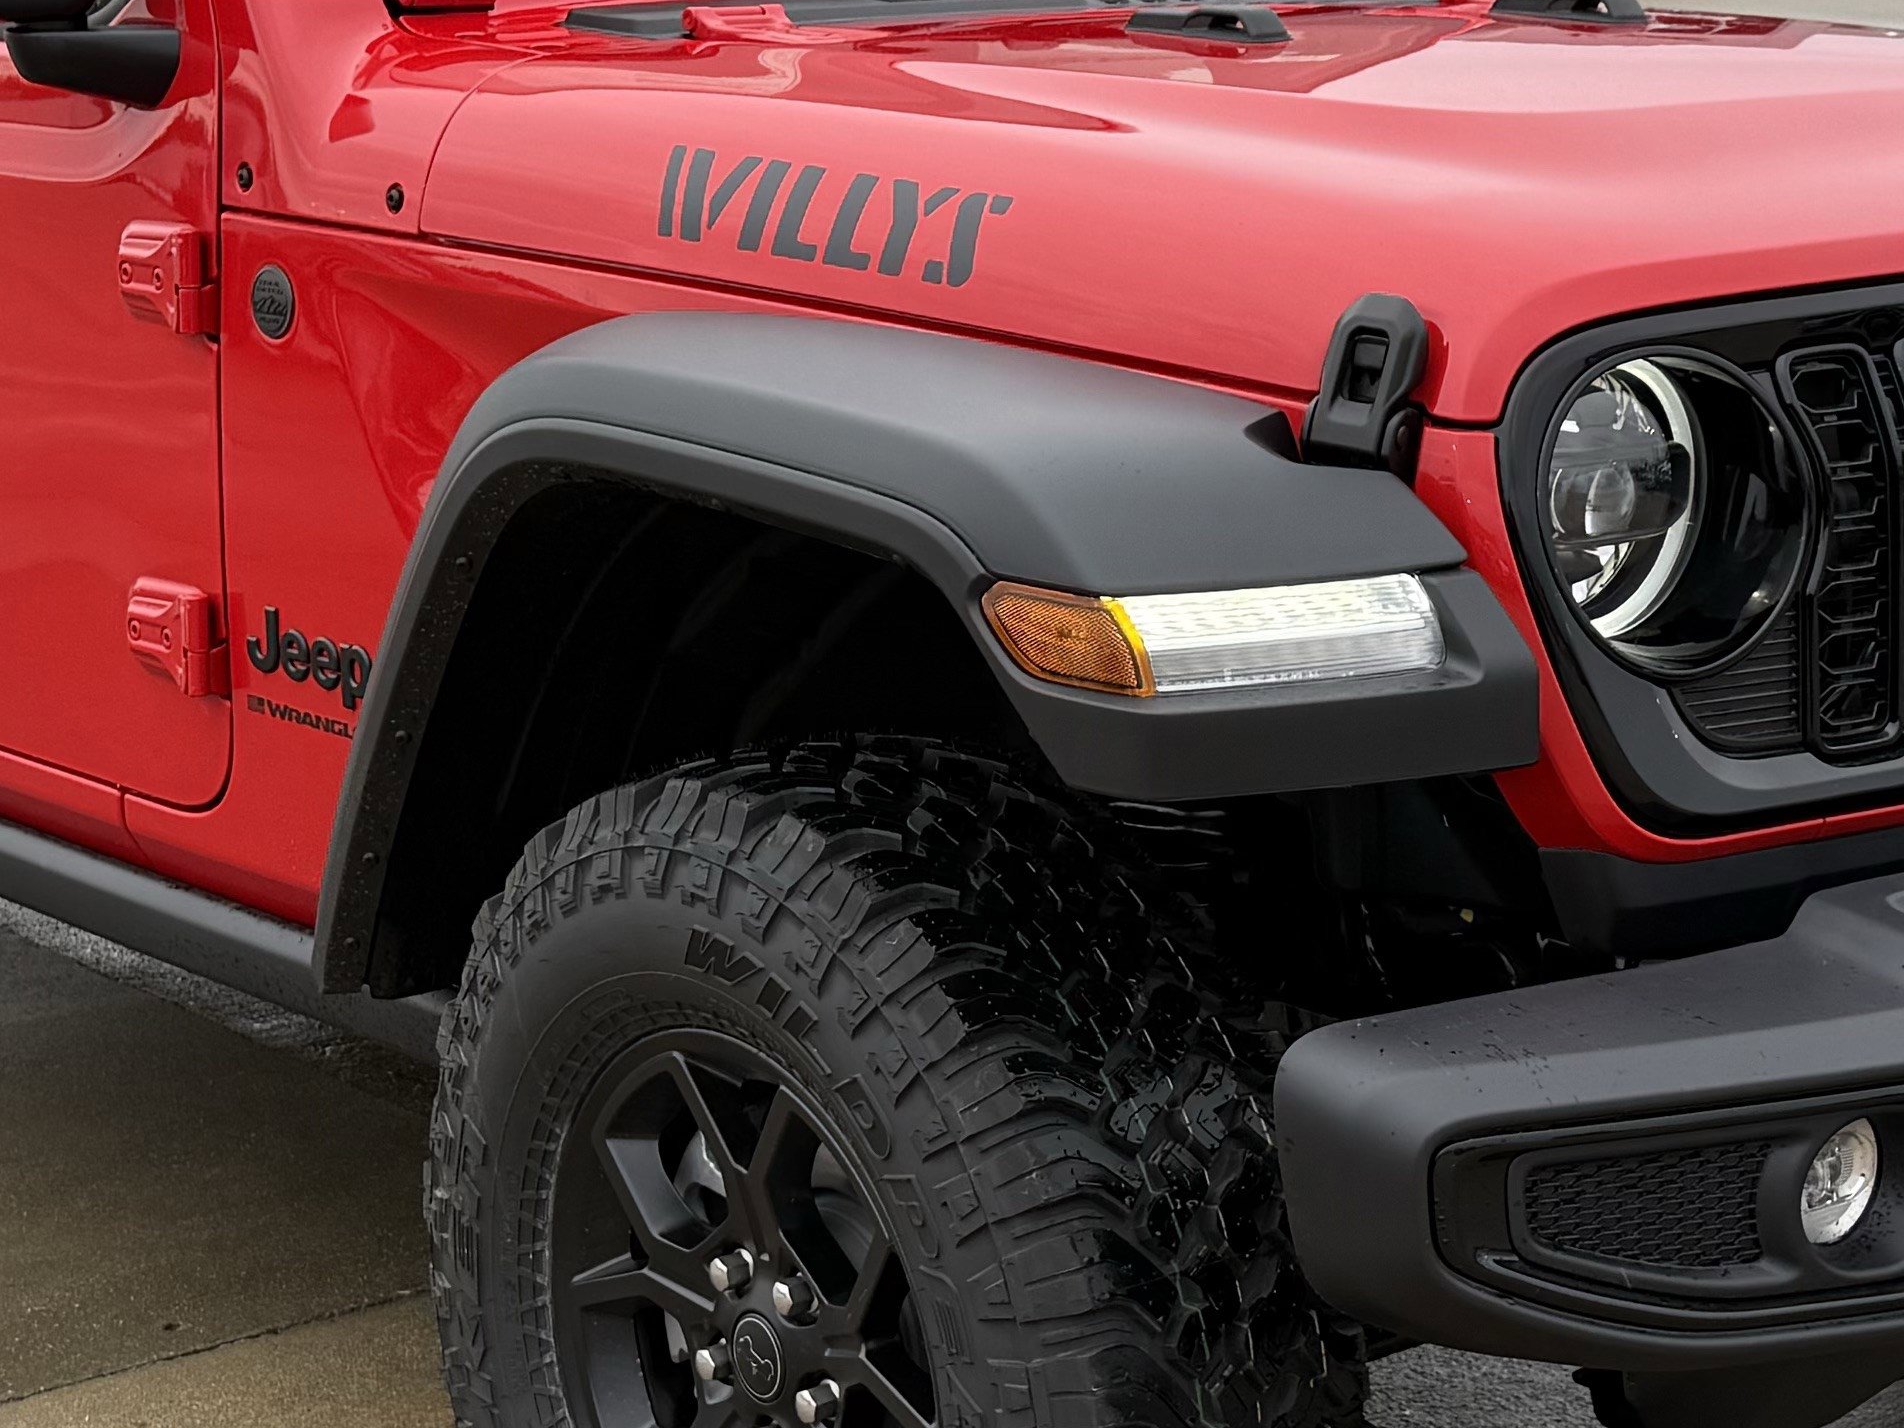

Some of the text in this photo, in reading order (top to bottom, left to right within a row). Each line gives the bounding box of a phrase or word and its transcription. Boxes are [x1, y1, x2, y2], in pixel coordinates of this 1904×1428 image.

[657, 144, 1014, 288] WILLYS
[246, 605, 373, 710] Jeep
[266, 699, 357, 740] WRANGL
